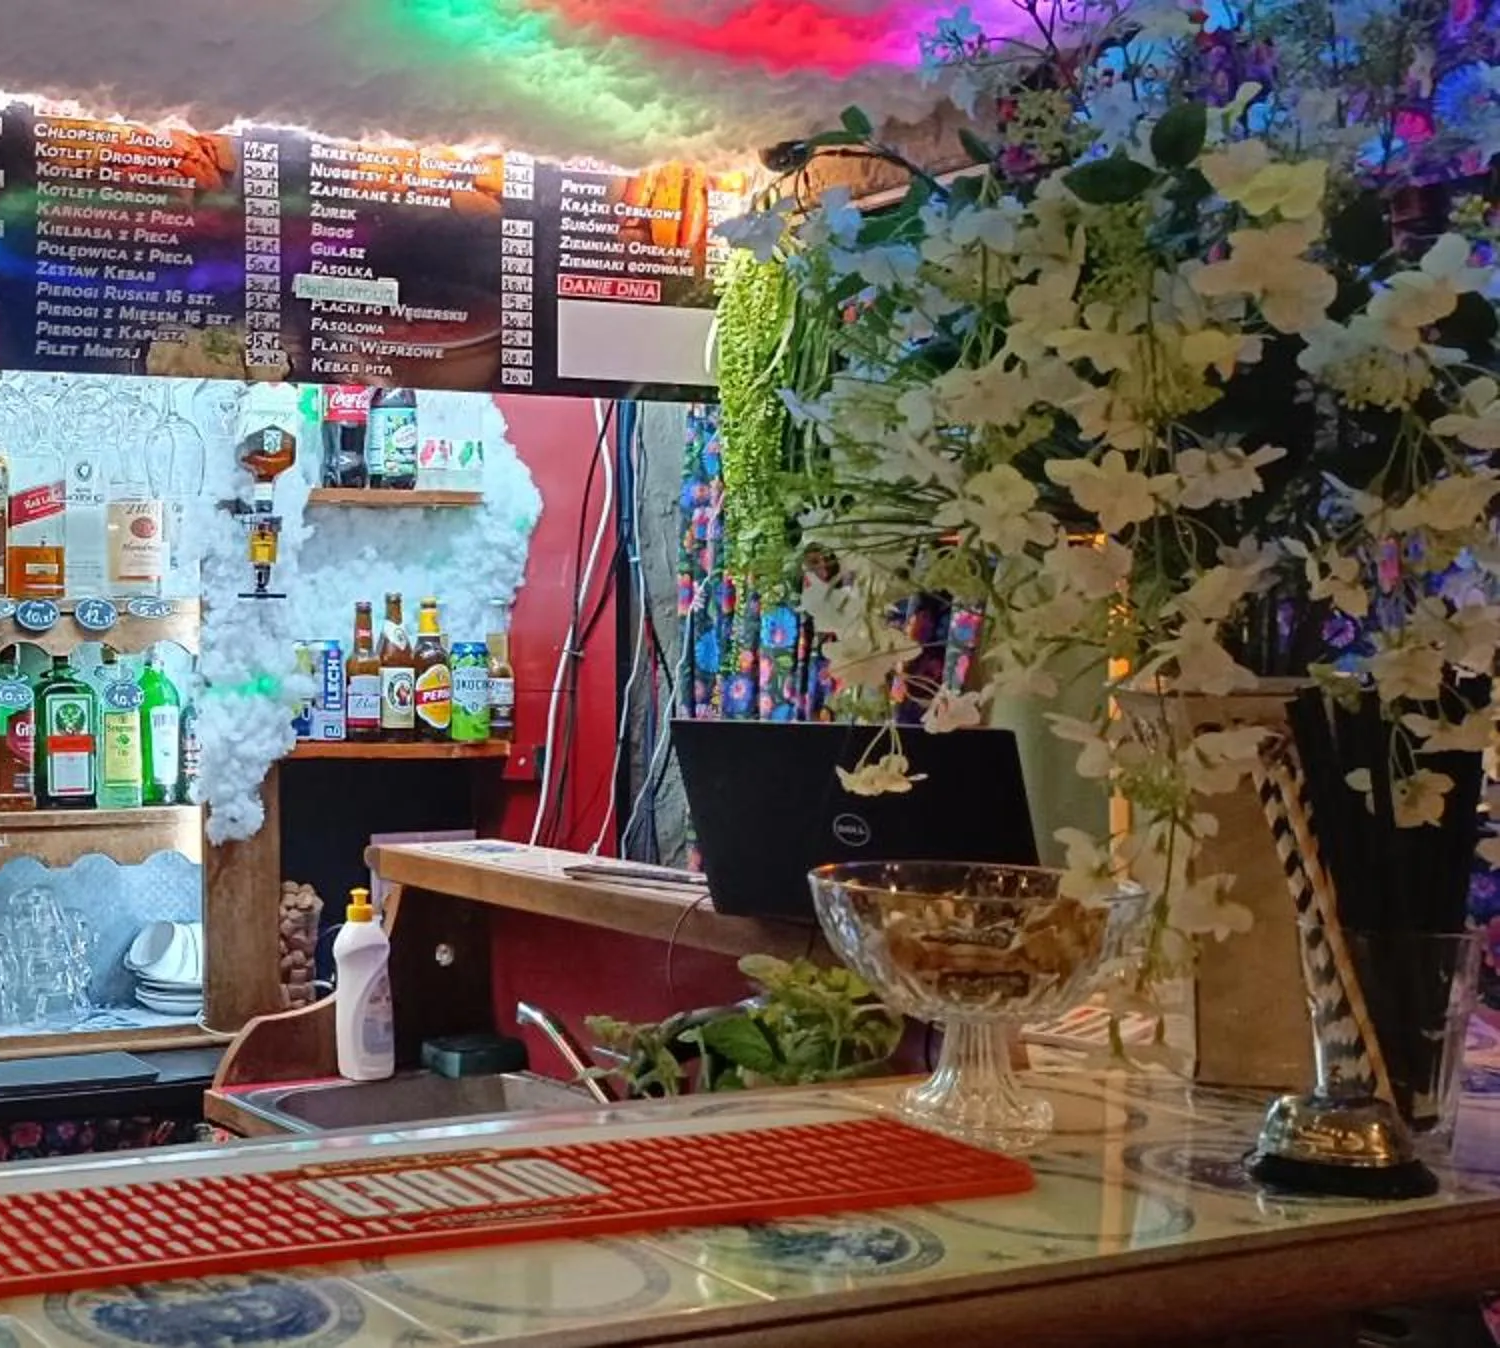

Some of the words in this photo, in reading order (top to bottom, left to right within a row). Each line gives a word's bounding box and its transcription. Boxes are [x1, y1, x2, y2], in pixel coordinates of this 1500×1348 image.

[34, 142, 93, 160] KOTLET
[36, 161, 93, 179] KOTLET
[36, 181, 93, 199] KOTLET
[151, 211, 195, 227] PIECA
[134, 228, 179, 245] PIECA
[311, 222, 354, 239] BIGOS
[149, 248, 194, 265] PIECA
[310, 242, 367, 259] GULASZ
[36, 260, 97, 277] ZESTAW
[311, 260, 374, 279] FASOLKA
[36, 282, 98, 300] PIEROGI
[104, 285, 160, 302] RUSKIE
[165, 289, 182, 305] 16
[562, 278, 613, 294] DANIE
[616, 281, 656, 298] DNIA
[36, 301, 98, 319] PIEROGI
[183, 308, 201, 324] 16
[36, 321, 98, 339] PIEROGI
[310, 317, 385, 335] FASOLOWA
[35, 340, 78, 358] FILET
[311, 338, 353, 353] FLAKI
[311, 357, 359, 373] KEBAB
